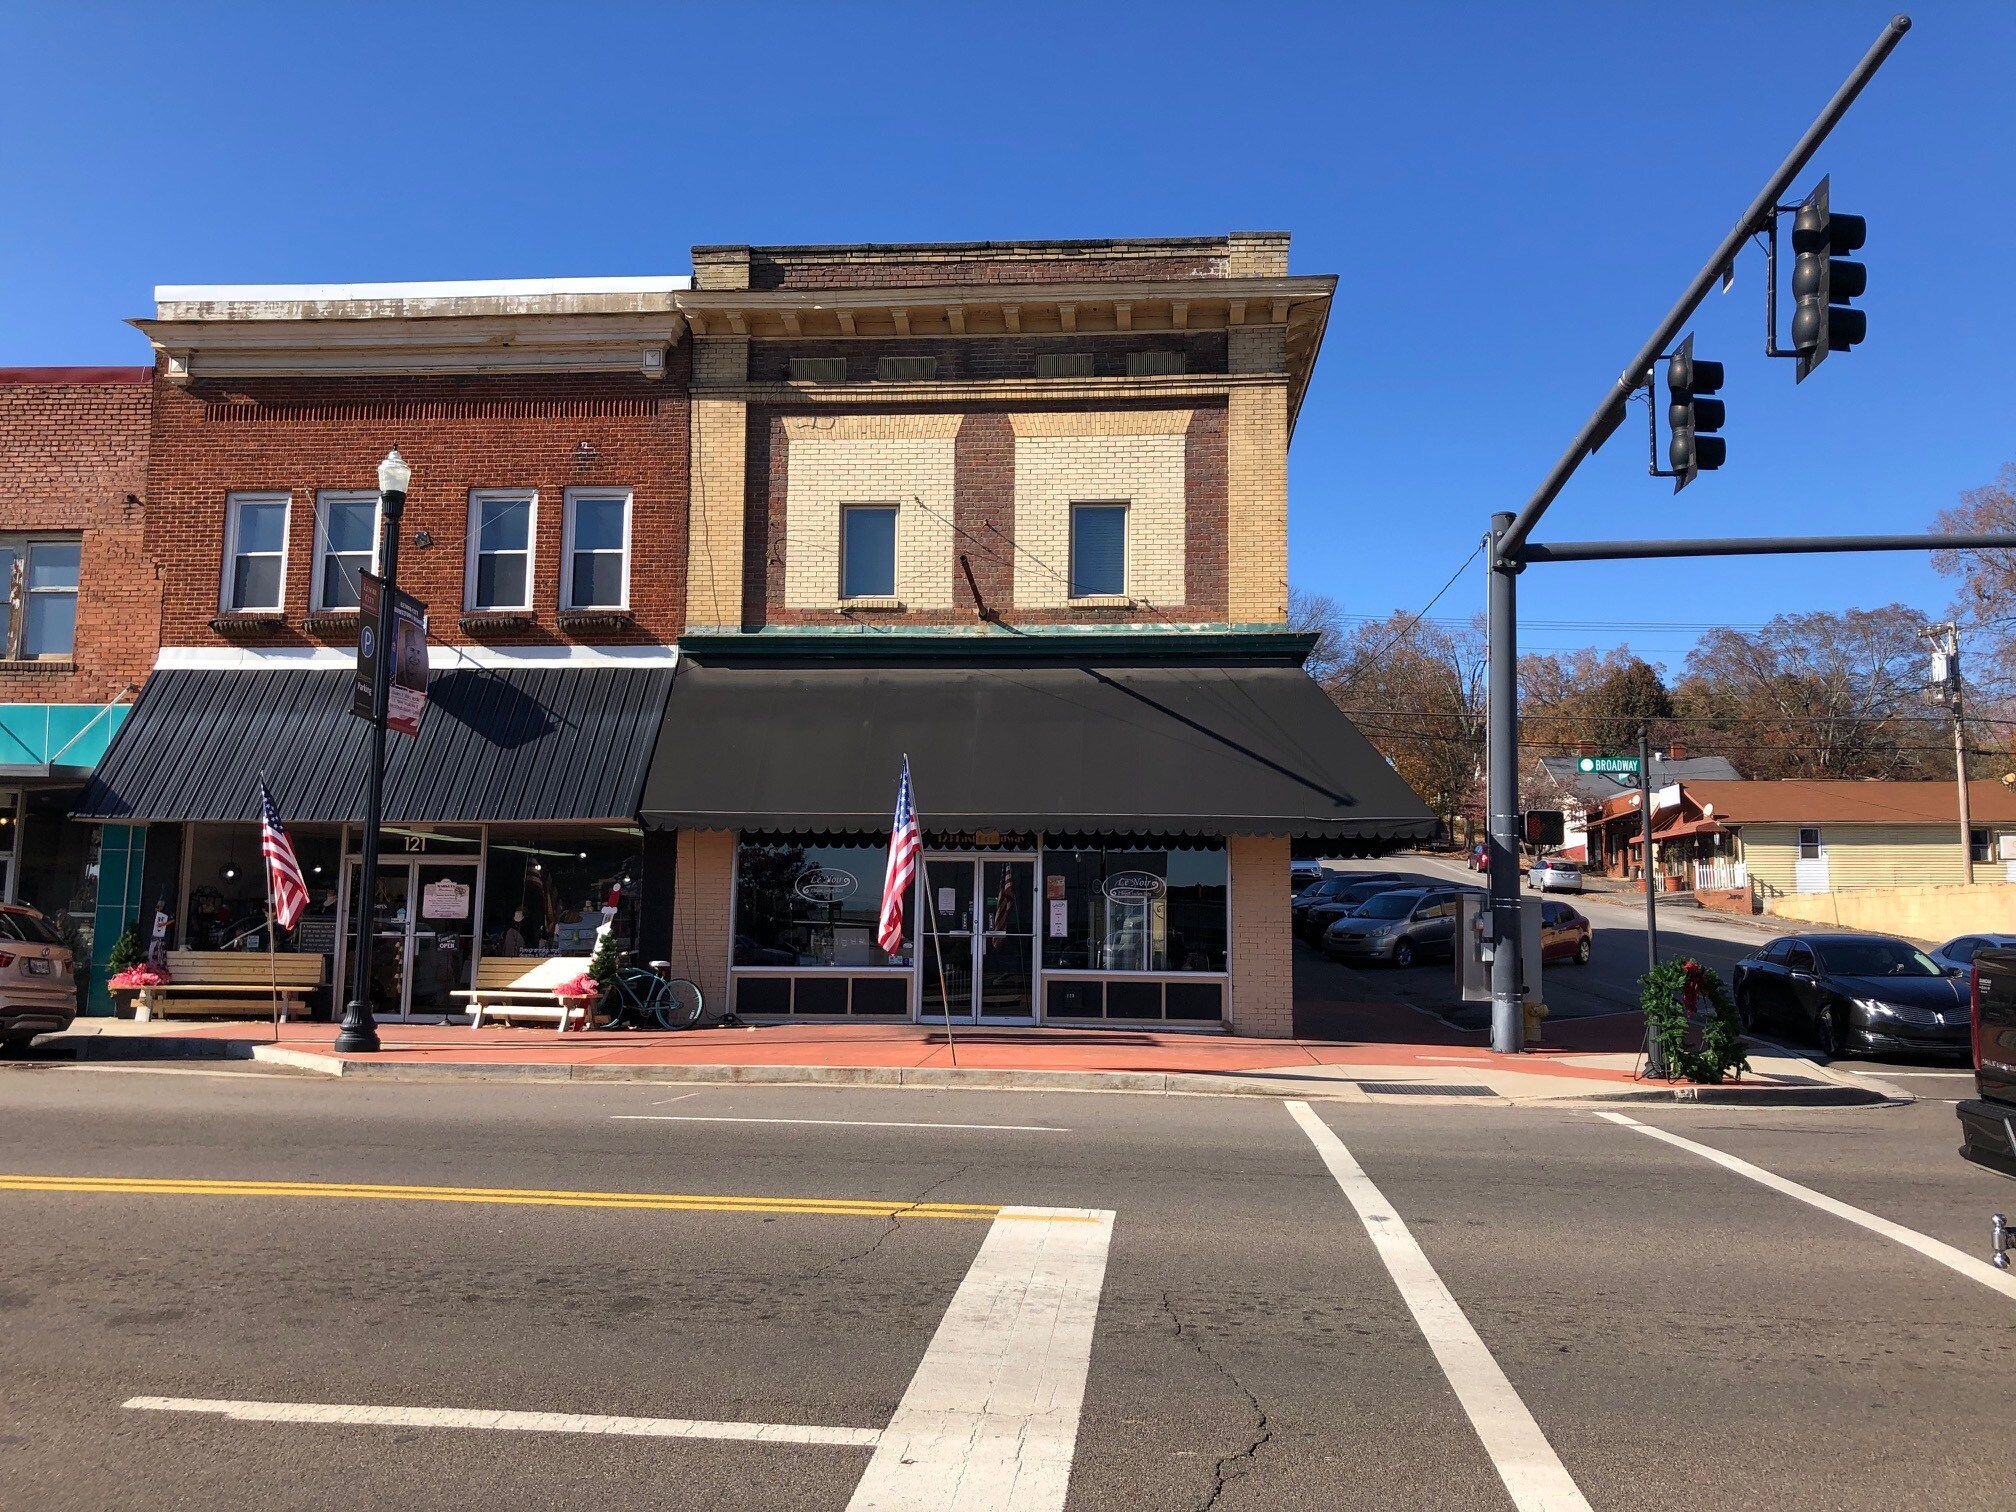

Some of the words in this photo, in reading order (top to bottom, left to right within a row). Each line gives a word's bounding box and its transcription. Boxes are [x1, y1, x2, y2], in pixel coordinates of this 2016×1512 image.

[357, 681, 372, 697] Parking
[1595, 760, 1638, 771] BROADWAY
[404, 836, 426, 852] 121
